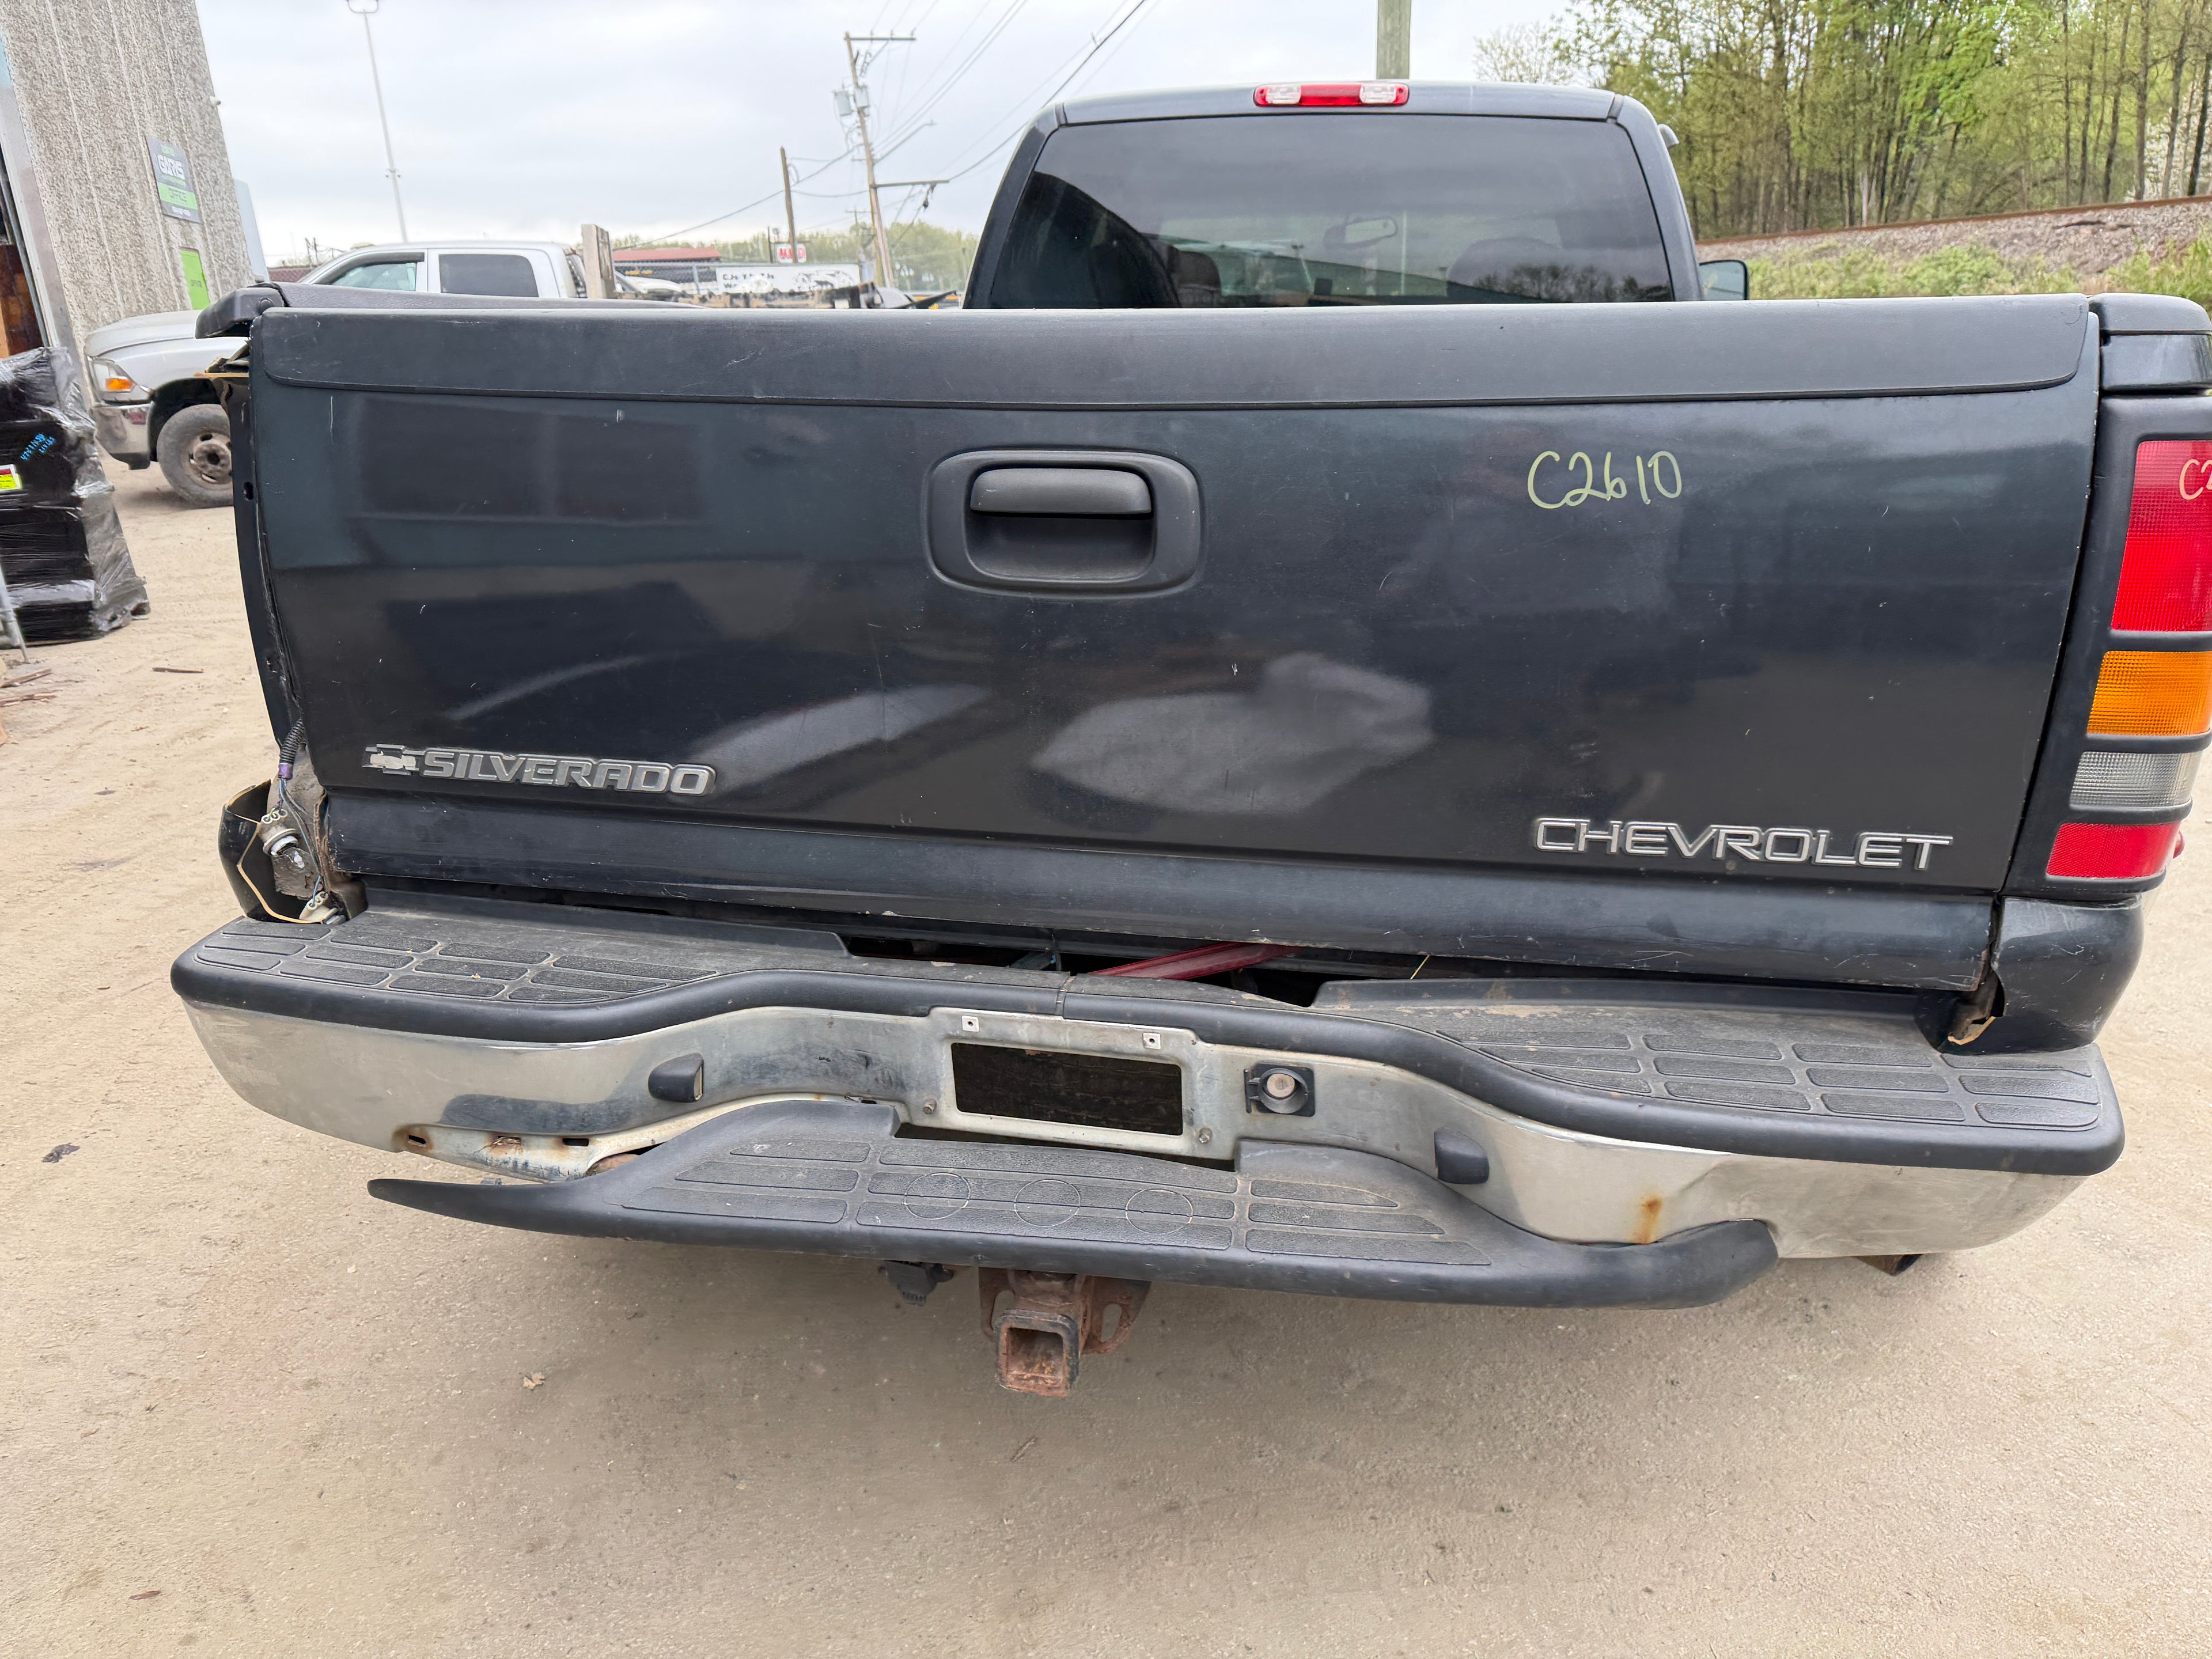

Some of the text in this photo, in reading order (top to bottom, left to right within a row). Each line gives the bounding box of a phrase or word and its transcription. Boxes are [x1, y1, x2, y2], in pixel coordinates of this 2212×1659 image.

[1528, 450, 1682, 509] C2610
[421, 748, 714, 796] SILVERADO
[1536, 817, 1953, 871] CHEVROLET
